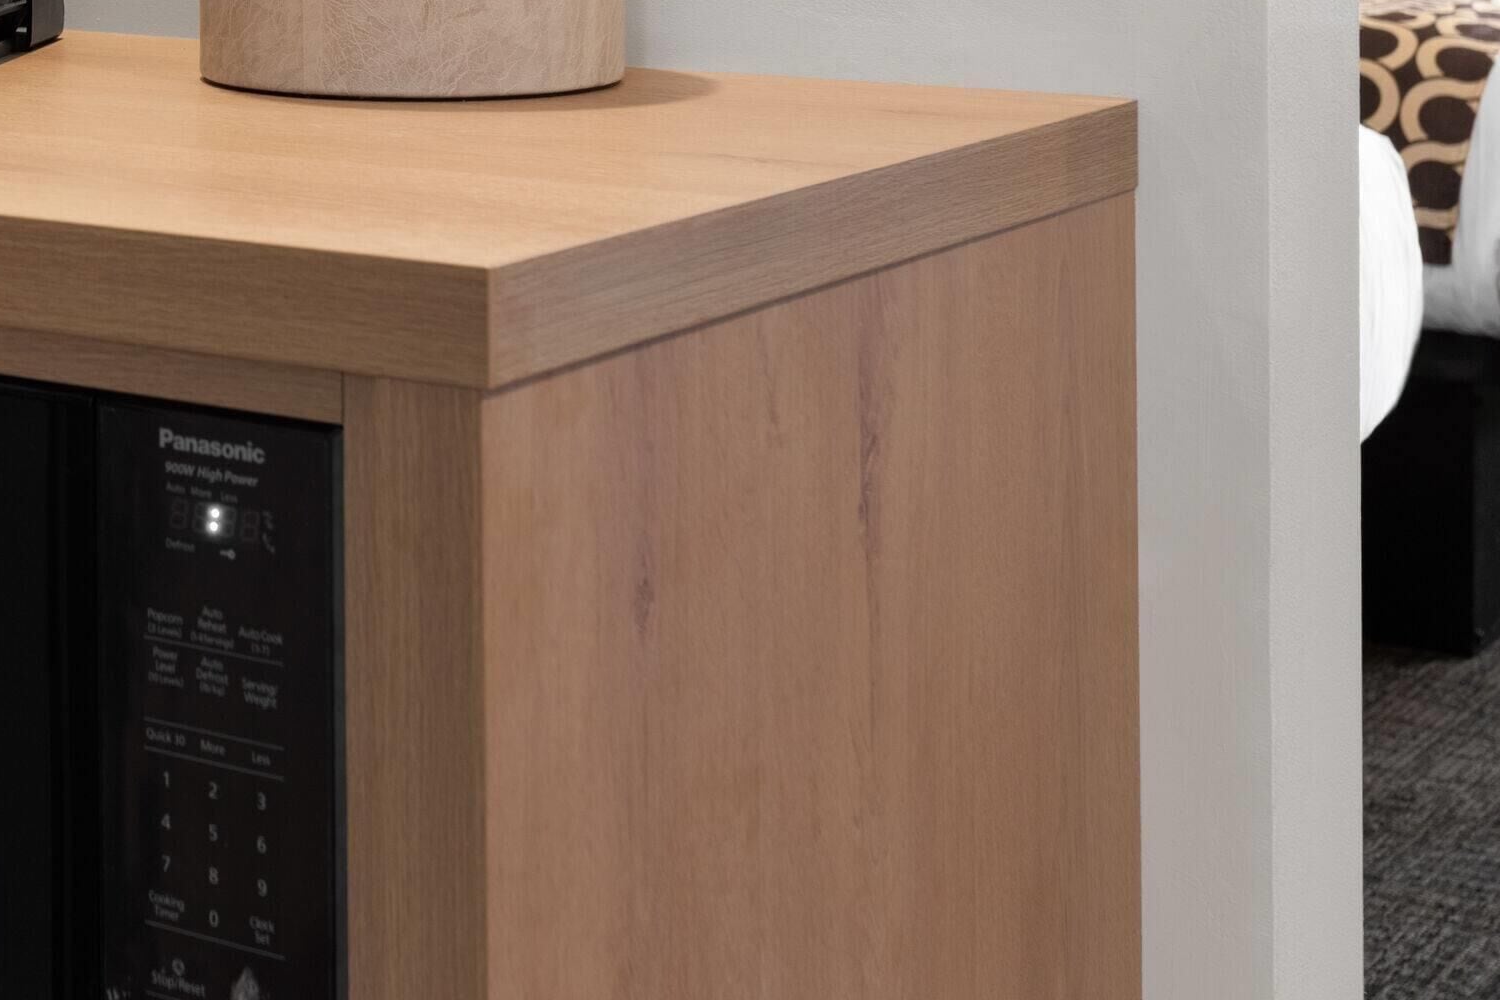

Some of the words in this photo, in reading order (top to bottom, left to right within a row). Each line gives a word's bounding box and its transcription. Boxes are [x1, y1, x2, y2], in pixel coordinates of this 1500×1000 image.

[159, 427, 266, 464] Panasonic
[197, 466, 223, 483] High
[224, 470, 259, 487] Power
[209, 781, 218, 800] 2
[257, 792, 267, 811] 3
[161, 813, 171, 830] 4
[209, 823, 218, 842] 5
[256, 835, 267, 854] 6
[162, 855, 171, 873] 7
[208, 866, 219, 885] 8
[257, 879, 268, 897] 9
[209, 909, 219, 928] 0
